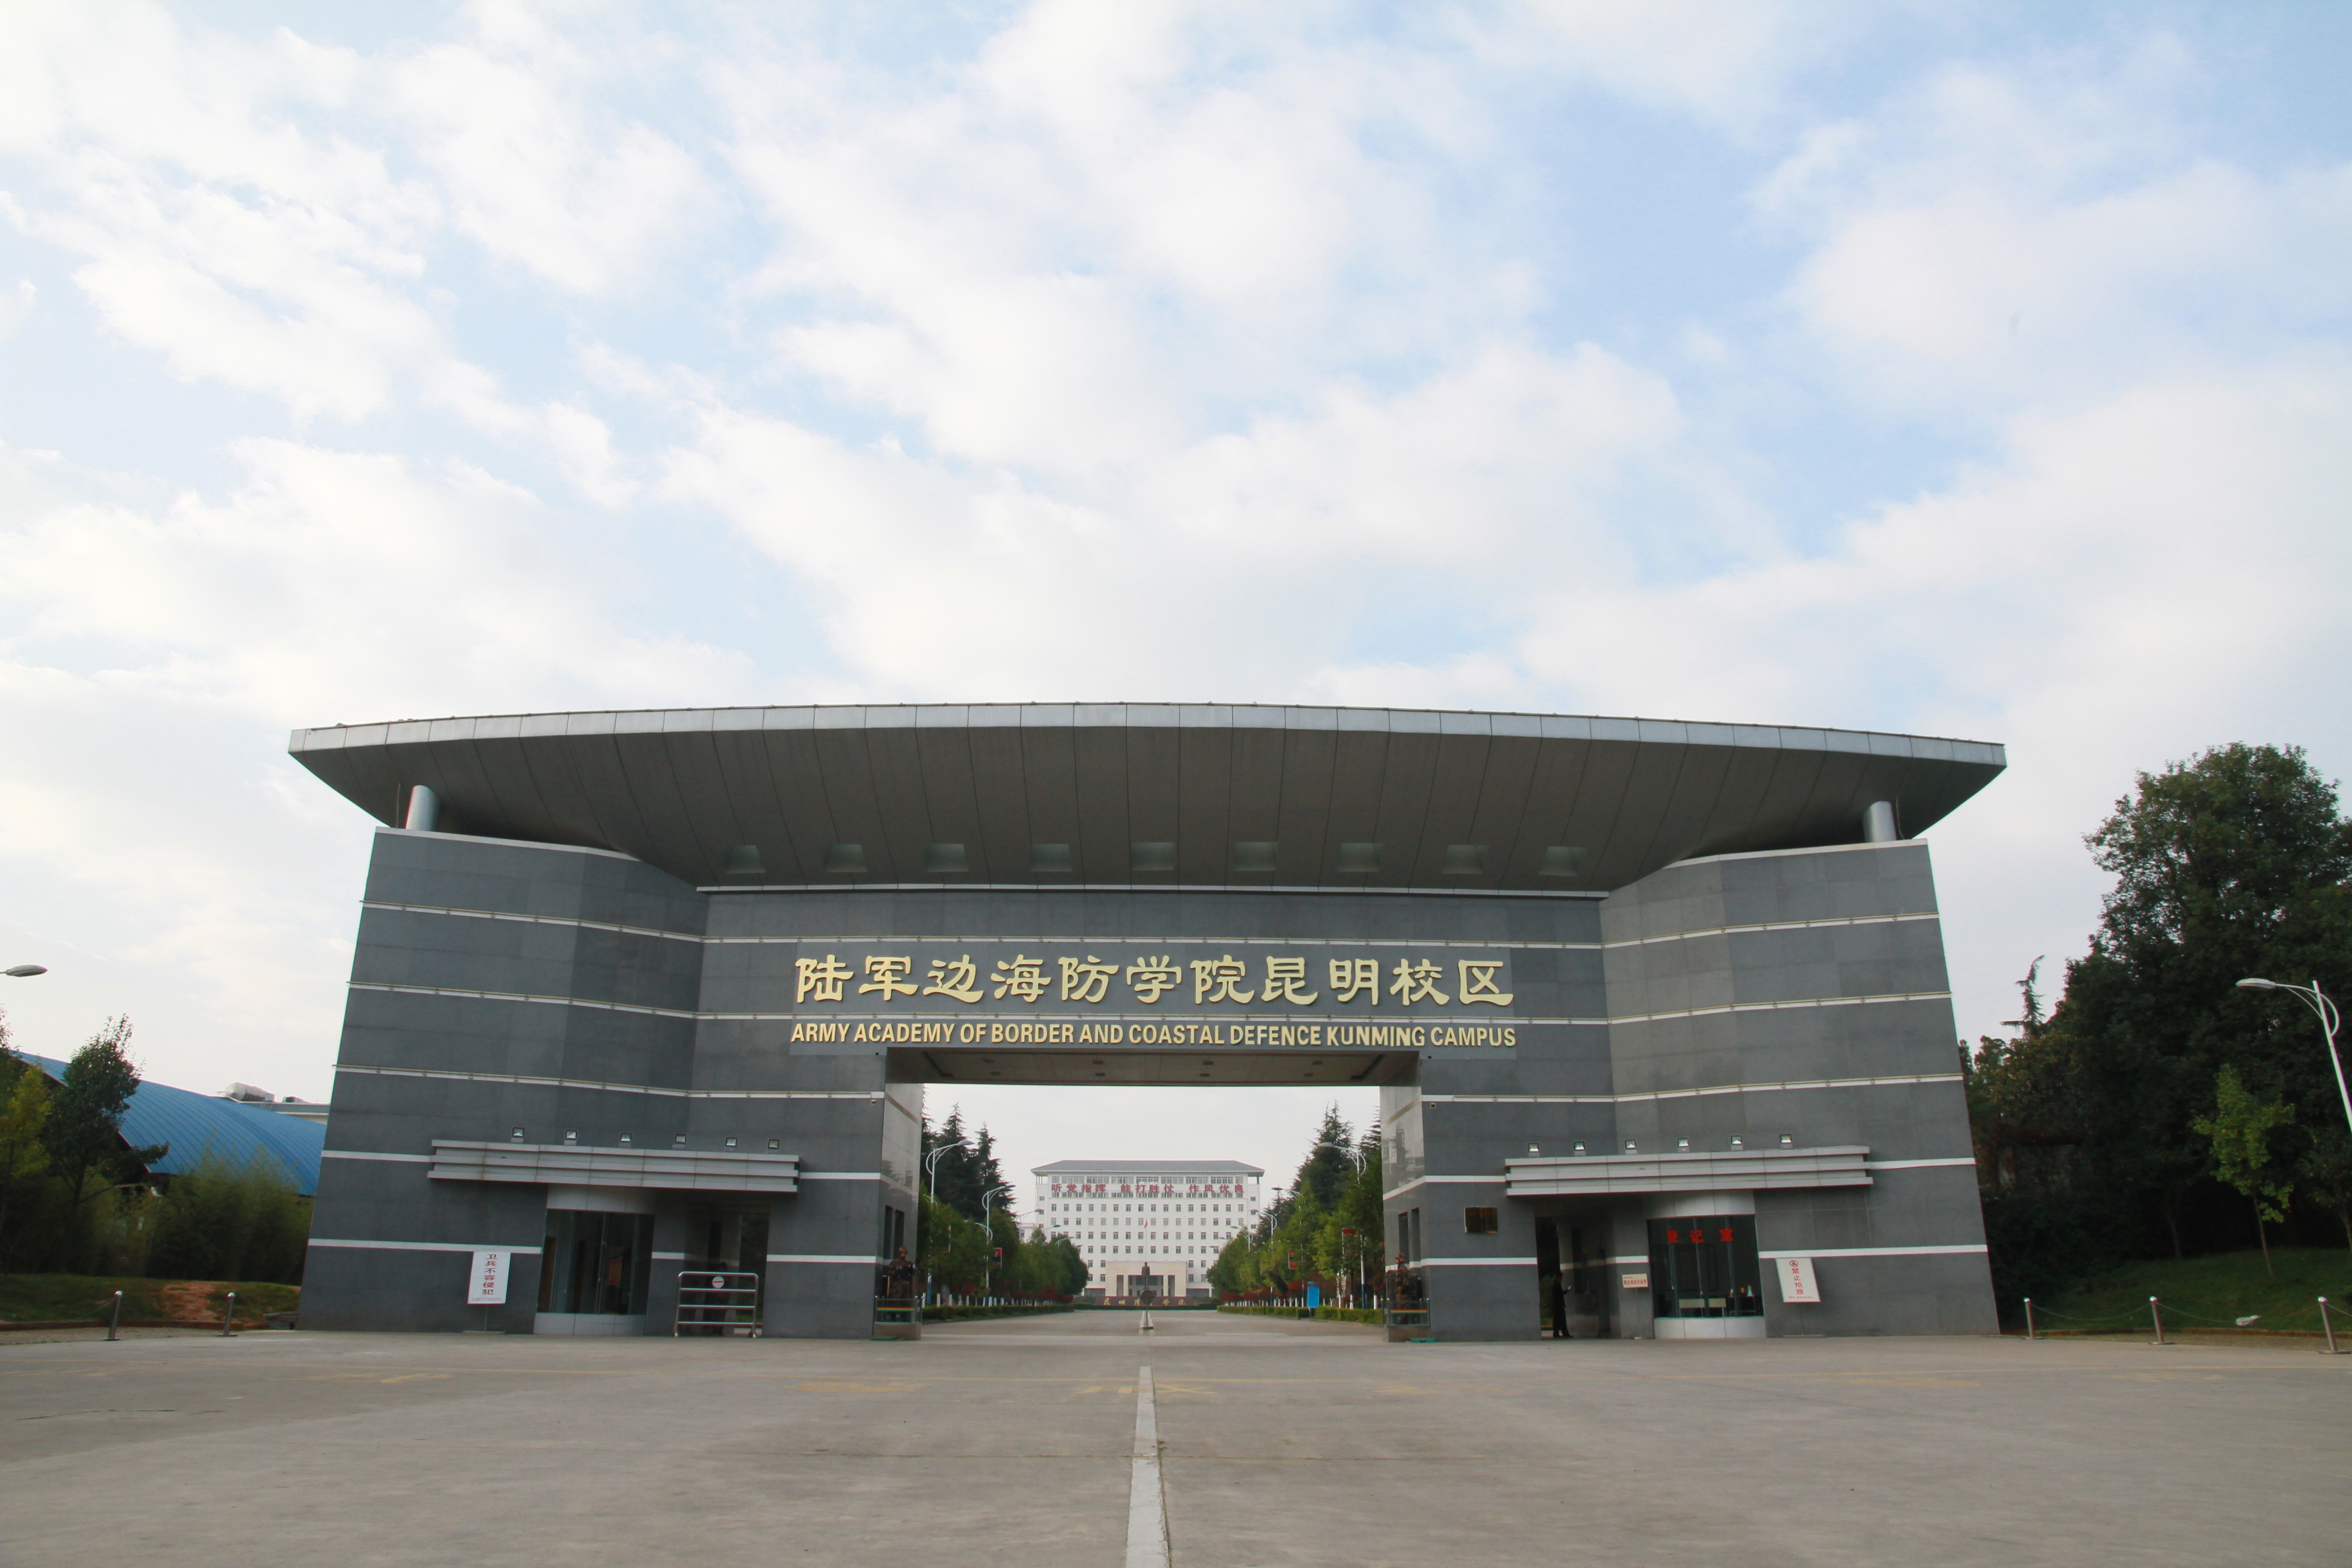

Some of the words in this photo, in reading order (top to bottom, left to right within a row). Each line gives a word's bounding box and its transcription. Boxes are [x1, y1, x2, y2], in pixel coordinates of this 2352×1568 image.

[794, 954, 1514, 1006] 陆军边海防学院昆明校区
[790, 1023, 850, 1043] ARMY
[853, 1023, 955, 1043] ACADEMY
[959, 1023, 987, 1044] OF
[990, 1024, 1074, 1044] BORDER
[1078, 1024, 1123, 1044] AND
[1128, 1024, 1225, 1045] COASTAL
[1230, 1026, 1321, 1046] DEFENCE
[1327, 1026, 1425, 1047] KUNMING
[1430, 1027, 1516, 1047] CAMPUS
[1051, 1183, 1106, 1193] 听党指挥
[1120, 1183, 1174, 1193] 能打胜仗
[1188, 1184, 1244, 1193] 作风优良
[1666, 1228, 1734, 1244] 登记室
[482, 1254, 498, 1295] 卫兵不容侵犯
[1792, 1268, 1804, 1295] 禁止拍照
